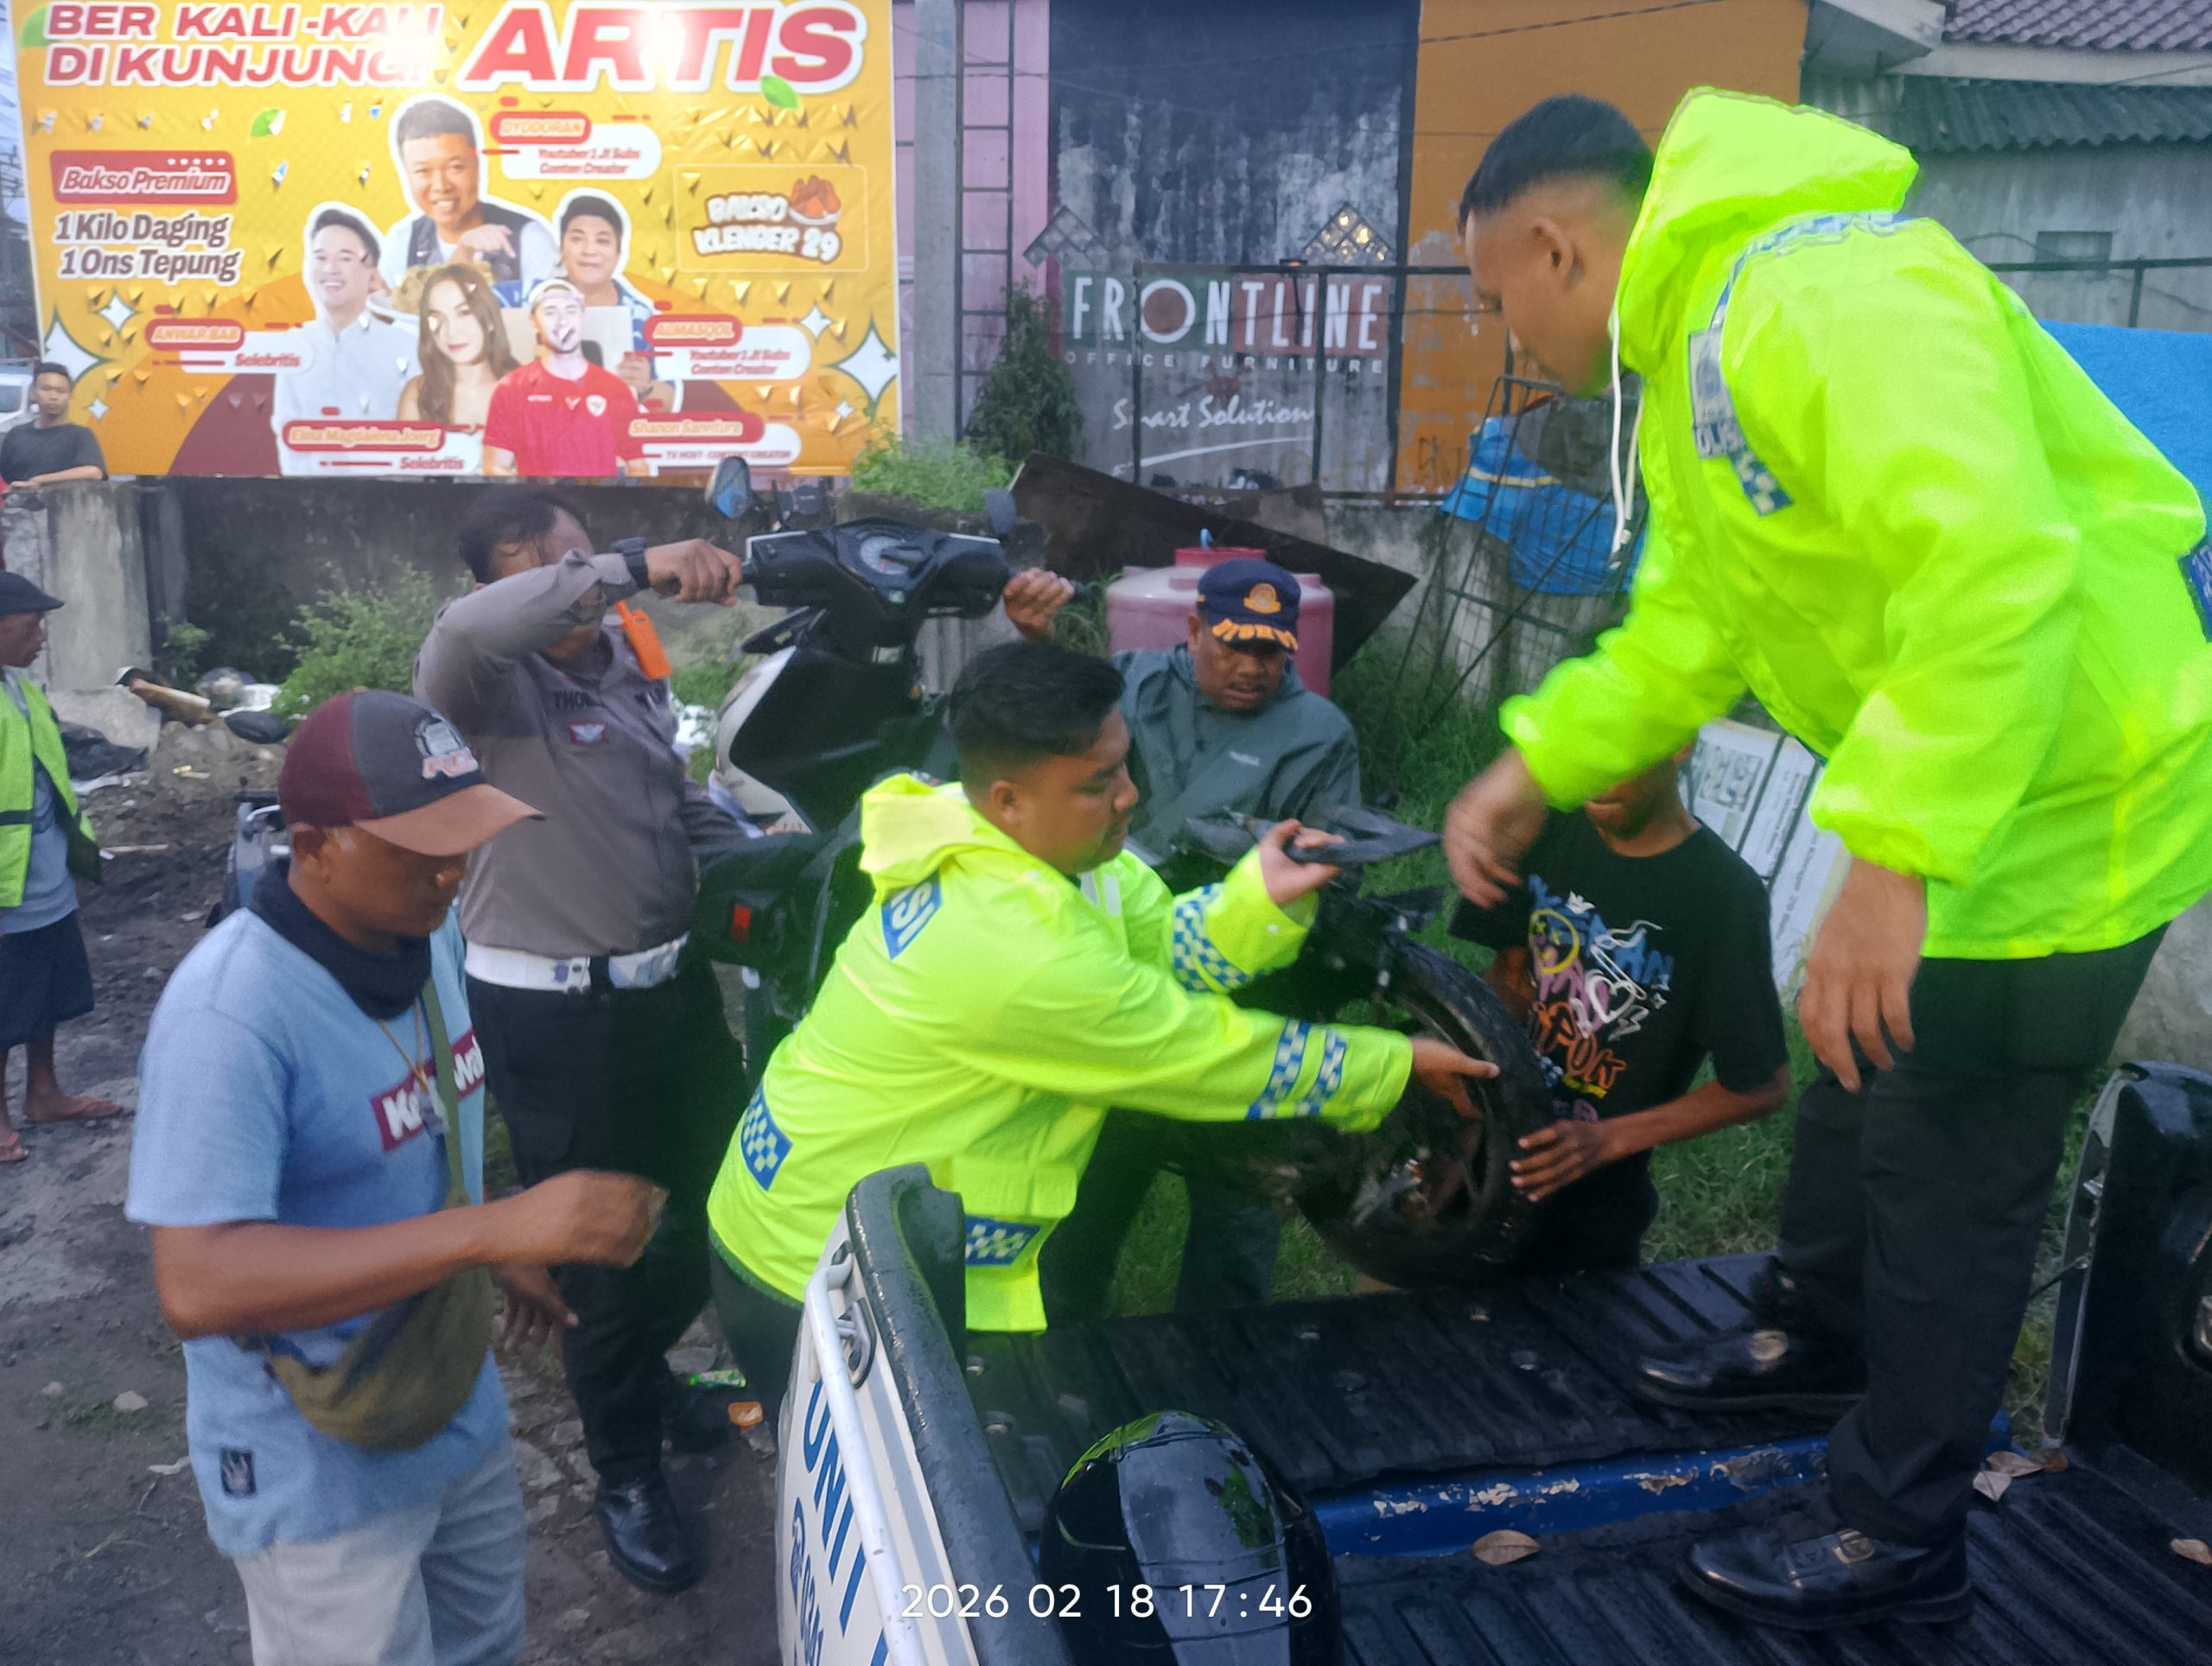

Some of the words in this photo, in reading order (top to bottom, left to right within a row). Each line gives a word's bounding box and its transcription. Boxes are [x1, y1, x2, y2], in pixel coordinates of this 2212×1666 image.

[48, 6, 155, 36] BER
[465, 8, 857, 82] ARTIS
[48, 48, 103, 81] DI
[117, 48, 422, 81] KUNJUNG
[63, 169, 130, 191] Bakso
[131, 169, 228, 191] Premium
[707, 194, 788, 224] BAKSO
[56, 214, 70, 240] 1
[75, 213, 129, 240] Kilo
[132, 213, 230, 248] Daging
[693, 225, 800, 256] KLENGER
[802, 226, 841, 262] 29
[61, 251, 77, 275] 1
[81, 249, 134, 275] Ons
[140, 249, 241, 283] Tepung
[1072, 276, 1383, 350] FRONTLINE
[235, 353, 301, 367] Selebritis
[735, 364, 779, 375] Creator
[1064, 351, 1176, 367] OFFICE
[1200, 355, 1382, 373] FURNITURE
[1113, 397, 1190, 429] Sart
[400, 456, 464, 470] Selebritis
